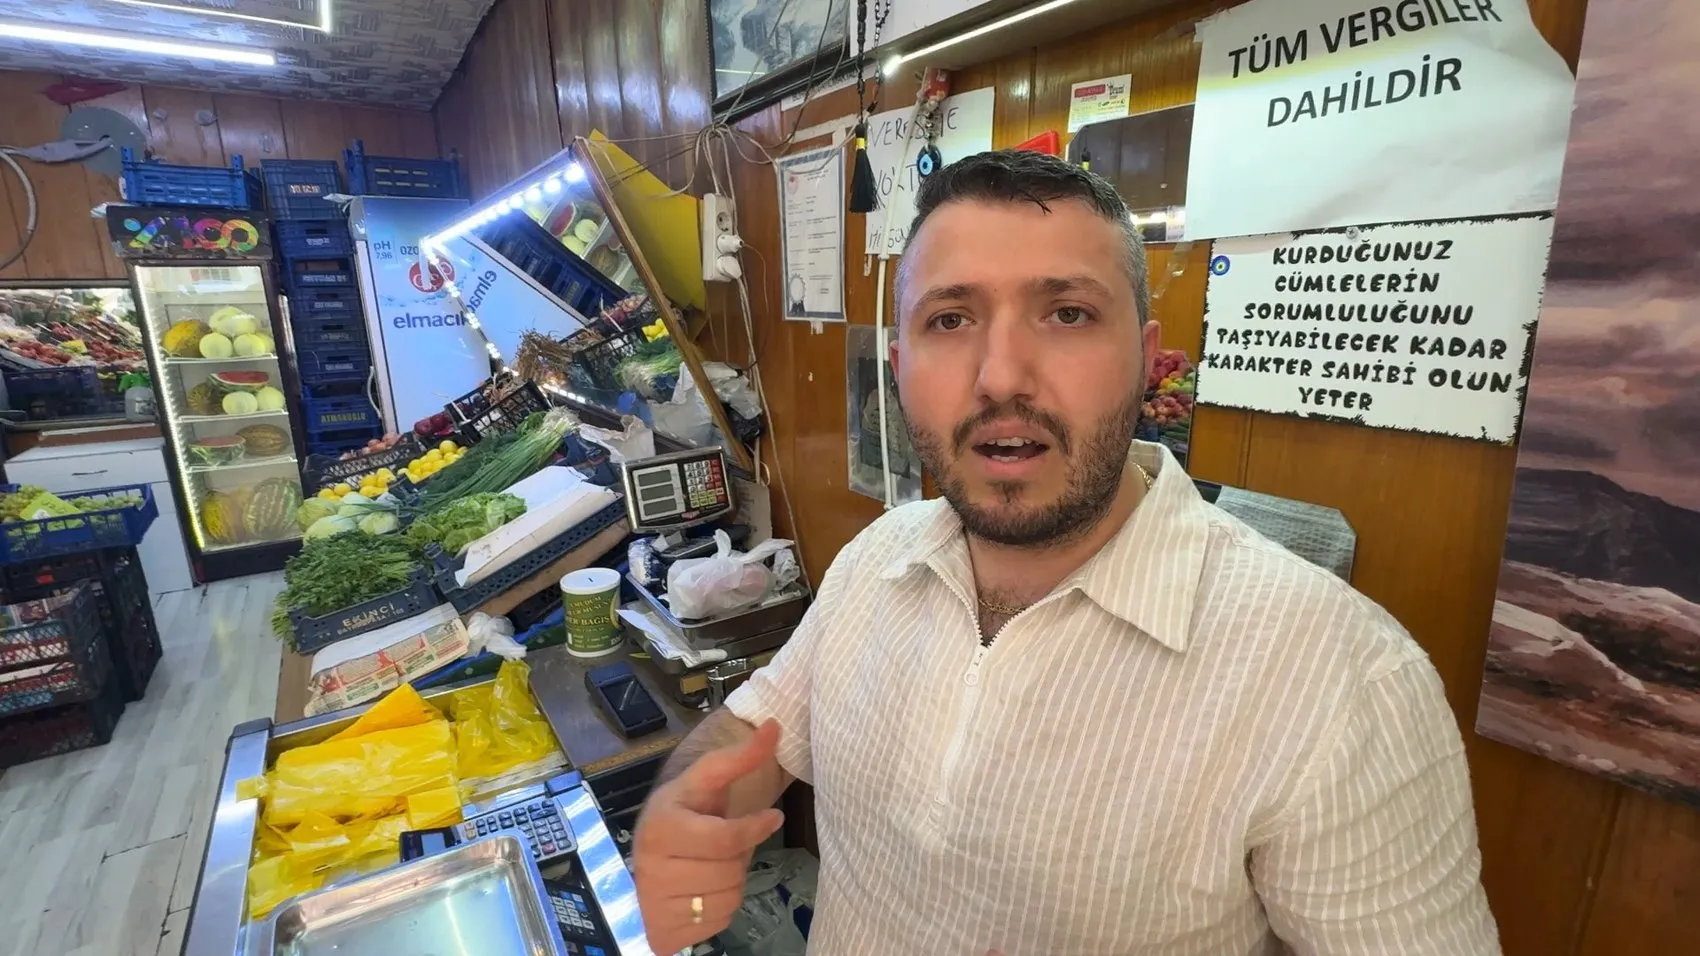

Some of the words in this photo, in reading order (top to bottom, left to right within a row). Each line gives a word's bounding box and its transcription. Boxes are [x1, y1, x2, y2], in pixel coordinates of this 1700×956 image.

[1228, 30, 1308, 79] TÜM
[1266, 54, 1463, 128] DAHİLDİR
[374, 241, 392, 252] pH
[1273, 239, 1454, 266] KURDUĞUNUZ
[1274, 267, 1441, 294] CÜMLELERİN
[1244, 300, 1474, 326] SORUMLULUĞUNU
[1216, 327, 1399, 354] TAŞIYABİLECEK
[1410, 336, 1507, 360] KADAR
[1208, 353, 1312, 378] KARAKTER
[1321, 359, 1416, 386] SAHİBİ
[1428, 368, 1512, 394] OLUN
[1299, 386, 1373, 411] YETER
